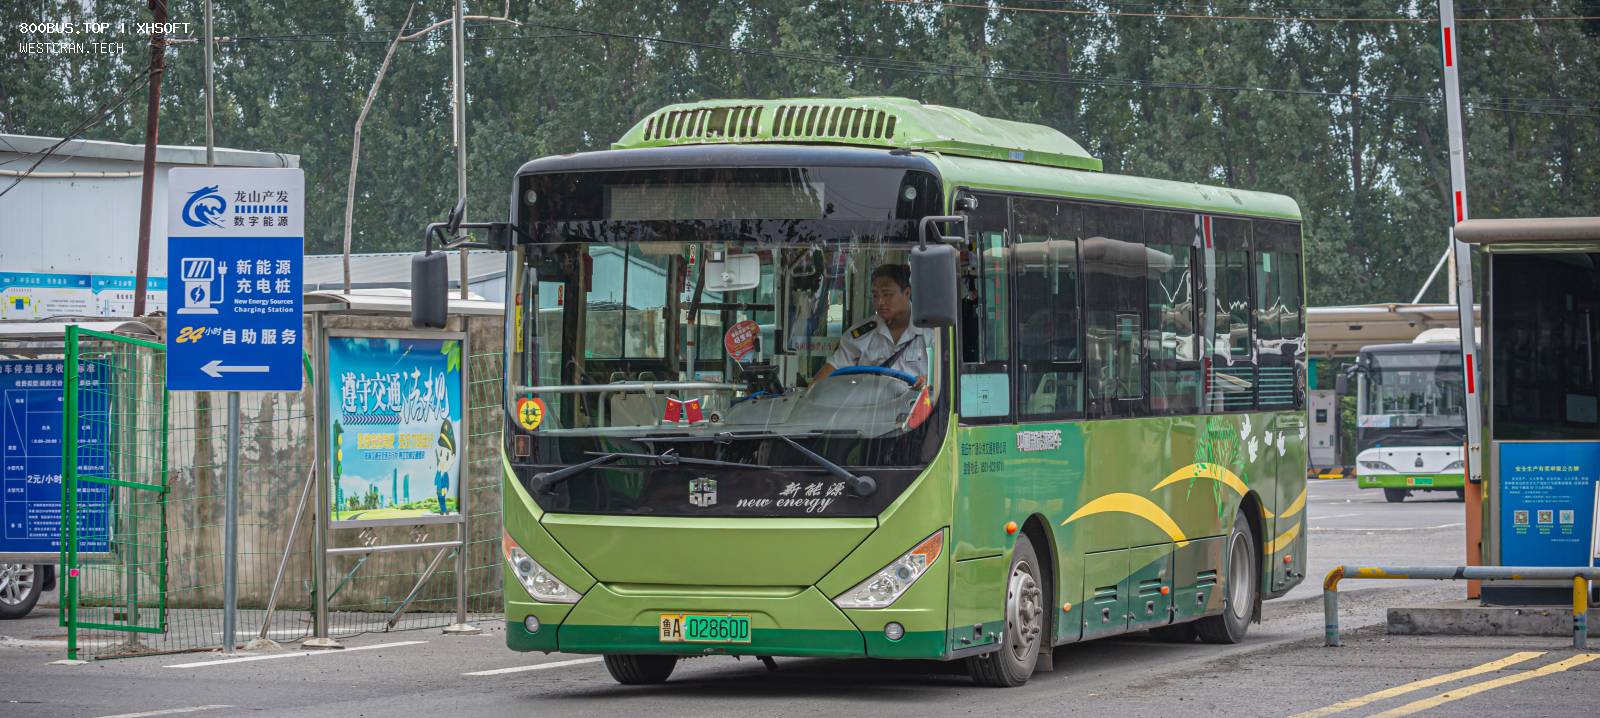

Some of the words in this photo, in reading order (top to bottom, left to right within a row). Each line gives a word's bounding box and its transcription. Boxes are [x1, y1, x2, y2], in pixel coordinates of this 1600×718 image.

[234, 190, 289, 203] 龙山产发
[234, 216, 289, 227] 数字能源
[236, 259, 291, 275] 新能源
[236, 278, 291, 294] 充电桩
[248, 298, 269, 306] Energy
[234, 306, 266, 314] Charging
[222, 328, 296, 345] 自助服务
[779, 482, 845, 497] 新能源
[736, 499, 772, 508] new
[776, 498, 835, 513] energy
[689, 618, 749, 639] 02860D
